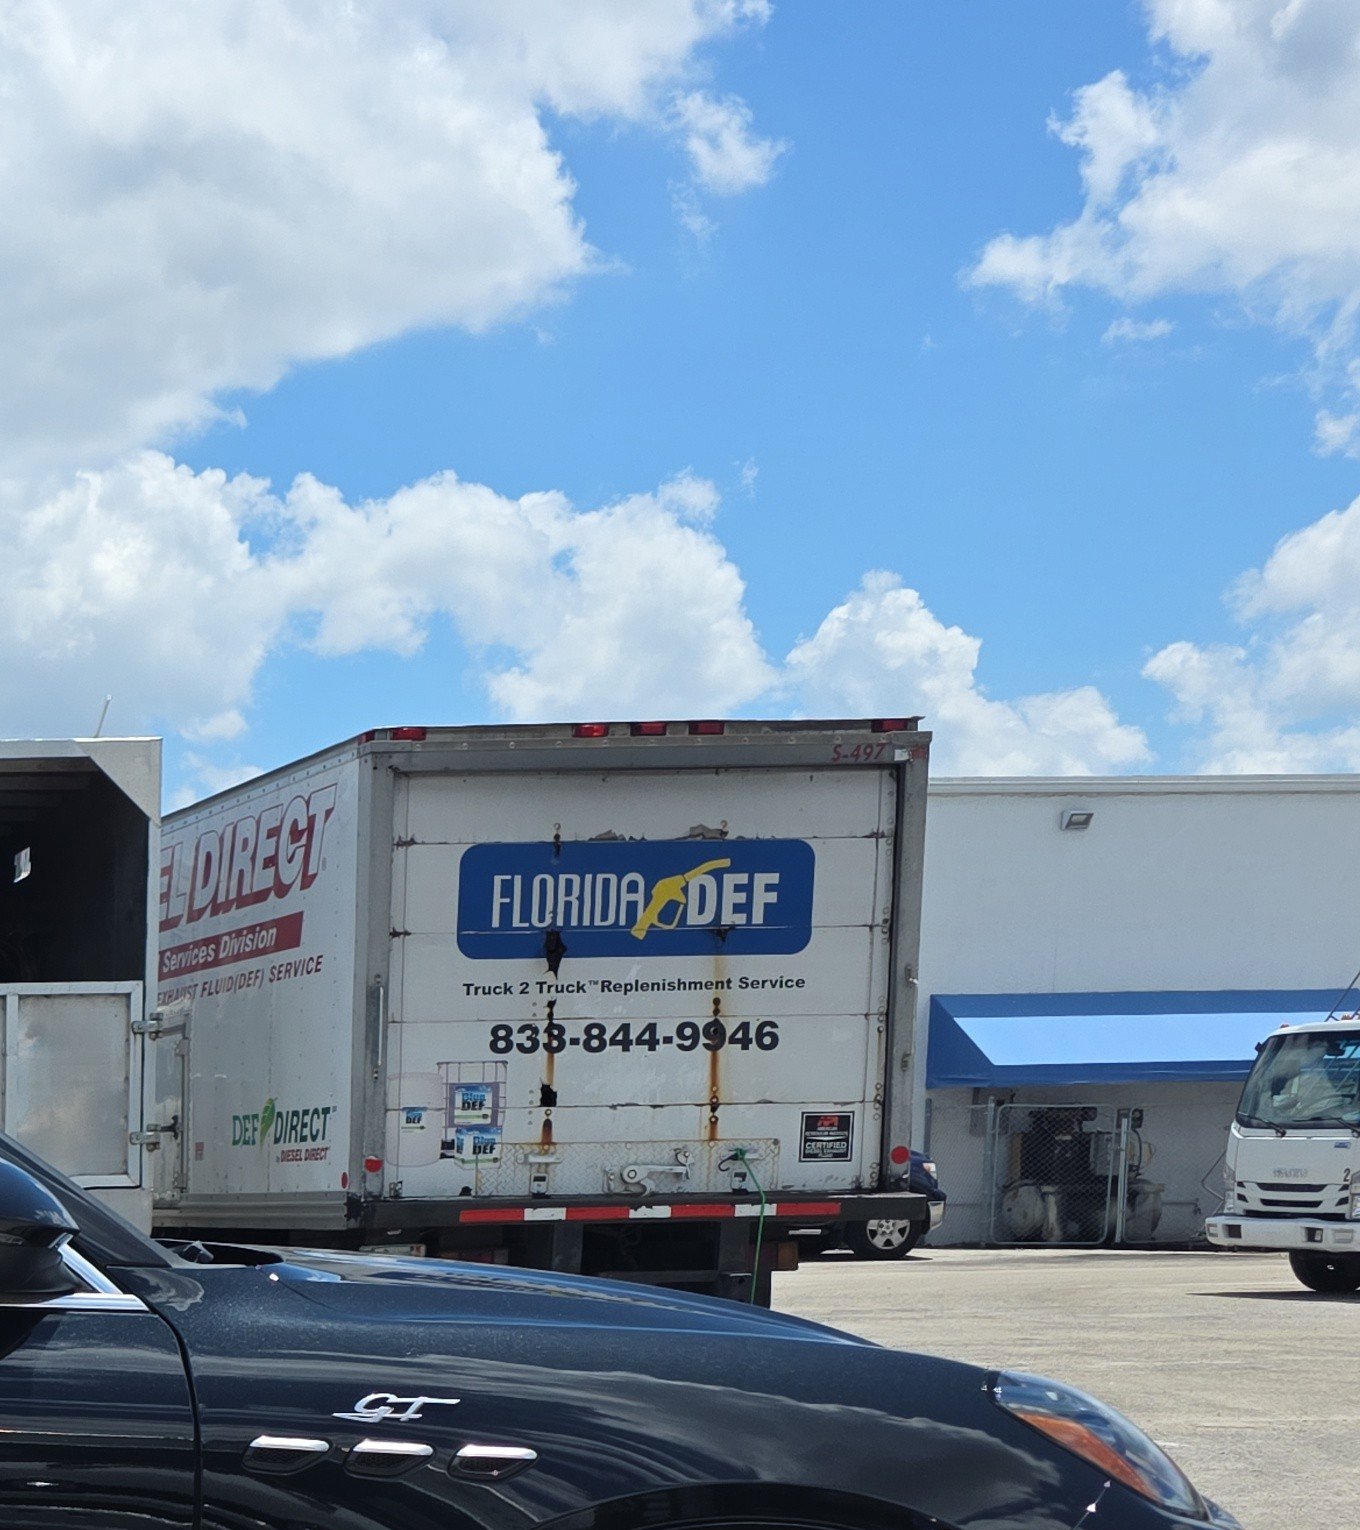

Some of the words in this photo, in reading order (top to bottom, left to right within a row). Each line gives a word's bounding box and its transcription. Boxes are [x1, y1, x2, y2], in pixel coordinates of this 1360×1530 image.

[831, 743, 890, 762] S-497
[186, 782, 338, 924] DIRECT
[491, 872, 646, 928] FLORIDA
[685, 872, 780, 926] DEF
[162, 942, 216, 973] Services
[219, 927, 278, 960] Division
[269, 955, 324, 983] SERVICE
[463, 982, 513, 997] Truck
[519, 981, 531, 996] 2
[738, 976, 806, 991] Service
[489, 1020, 780, 1055] 833-844-9946
[405, 1116, 422, 1124] DEF
[461, 1101, 486, 1111] DEF
[232, 1113, 259, 1146] DEF
[273, 1106, 331, 1145] DIRECT
[280, 1148, 303, 1162] DIESEL
[304, 1146, 329, 1161] DIRECT
[472, 1144, 496, 1155] DEF
[332, 1392, 461, 1424] GT
